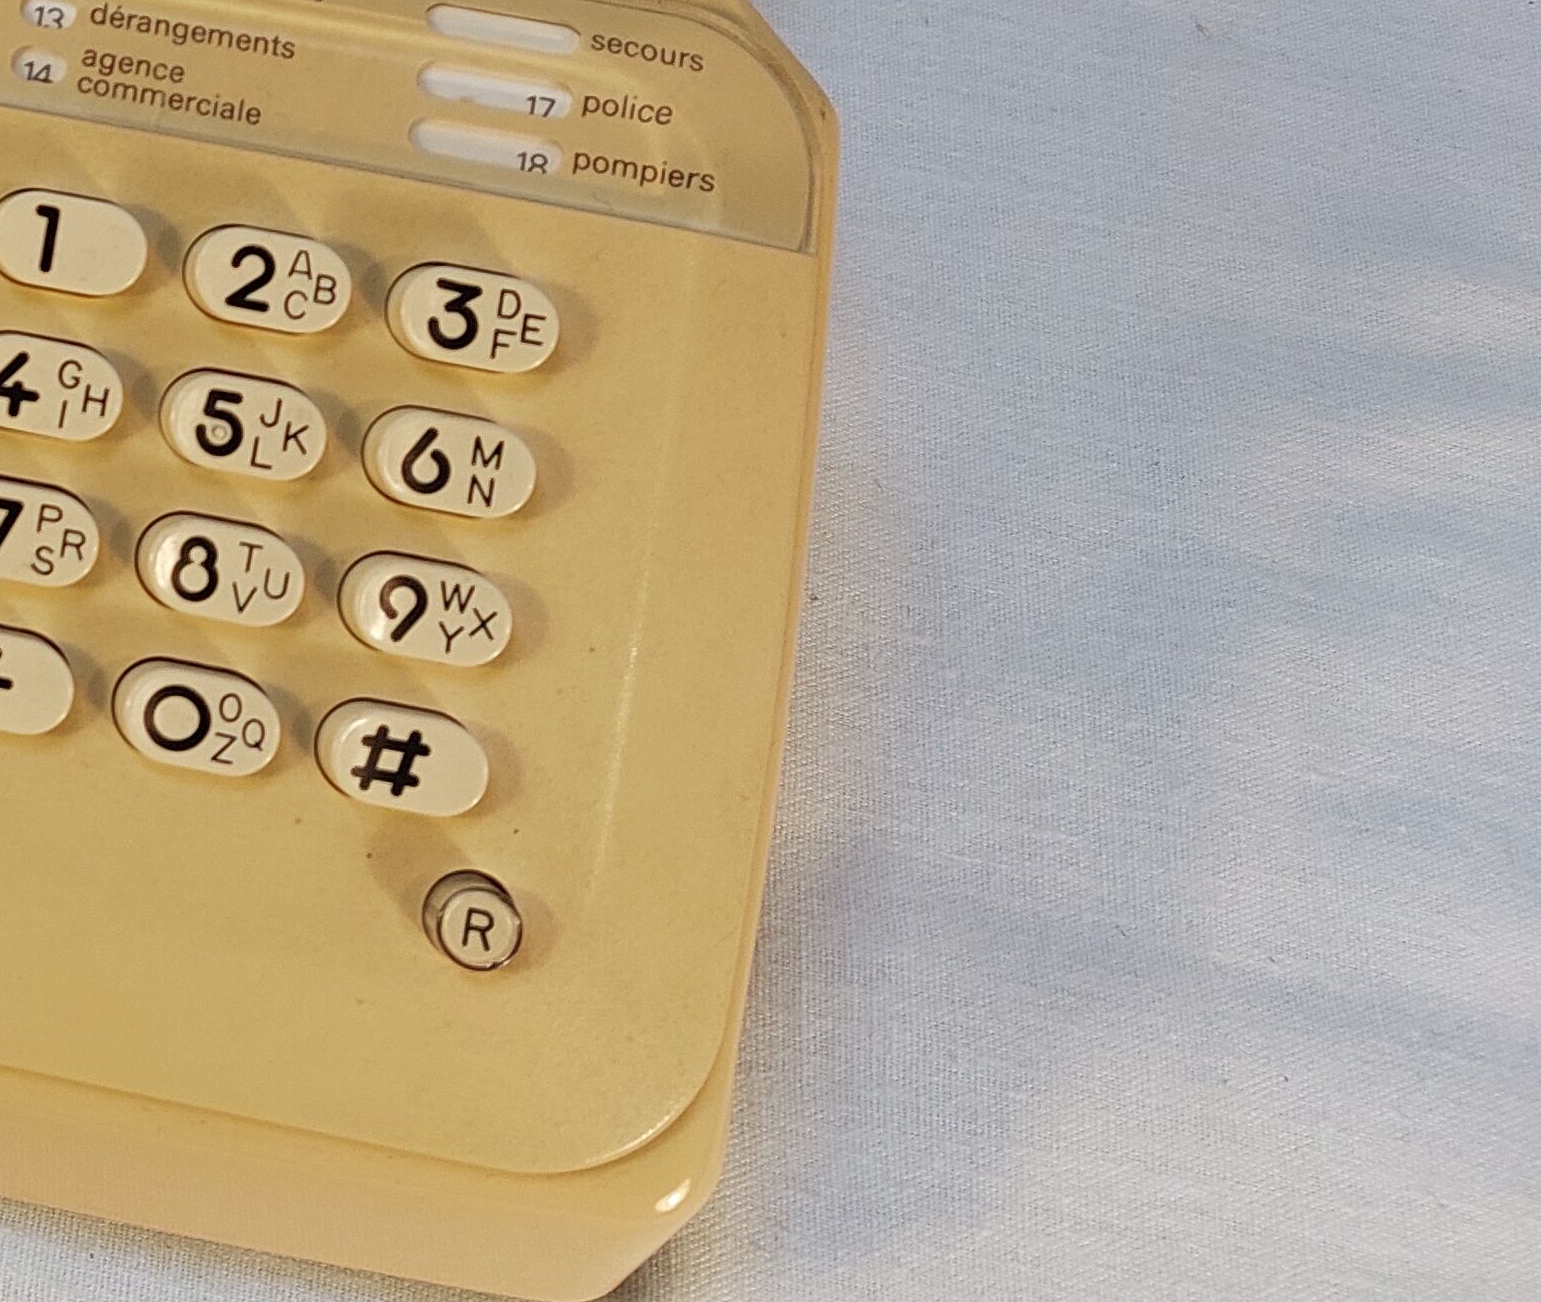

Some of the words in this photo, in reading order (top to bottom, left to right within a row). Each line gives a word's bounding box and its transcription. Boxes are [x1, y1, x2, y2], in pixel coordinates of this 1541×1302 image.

[89, 2, 296, 60] dérangements
[590, 33, 705, 72] secours
[23, 60, 55, 85] 14
[81, 48, 186, 84] agence
[77, 74, 263, 126] commerciale
[525, 95, 557, 119] 17
[581, 94, 674, 126] police
[572, 151, 716, 193] pompiers
[35, 204, 61, 273] 1
[224, 244, 276, 313] 2
[426, 277, 484, 350] 3
[195, 389, 244, 457] 5
[401, 427, 452, 495] 6
[170, 535, 220, 603] 8
[378, 574, 429, 642] 9
[460, 907, 494, 953] R
